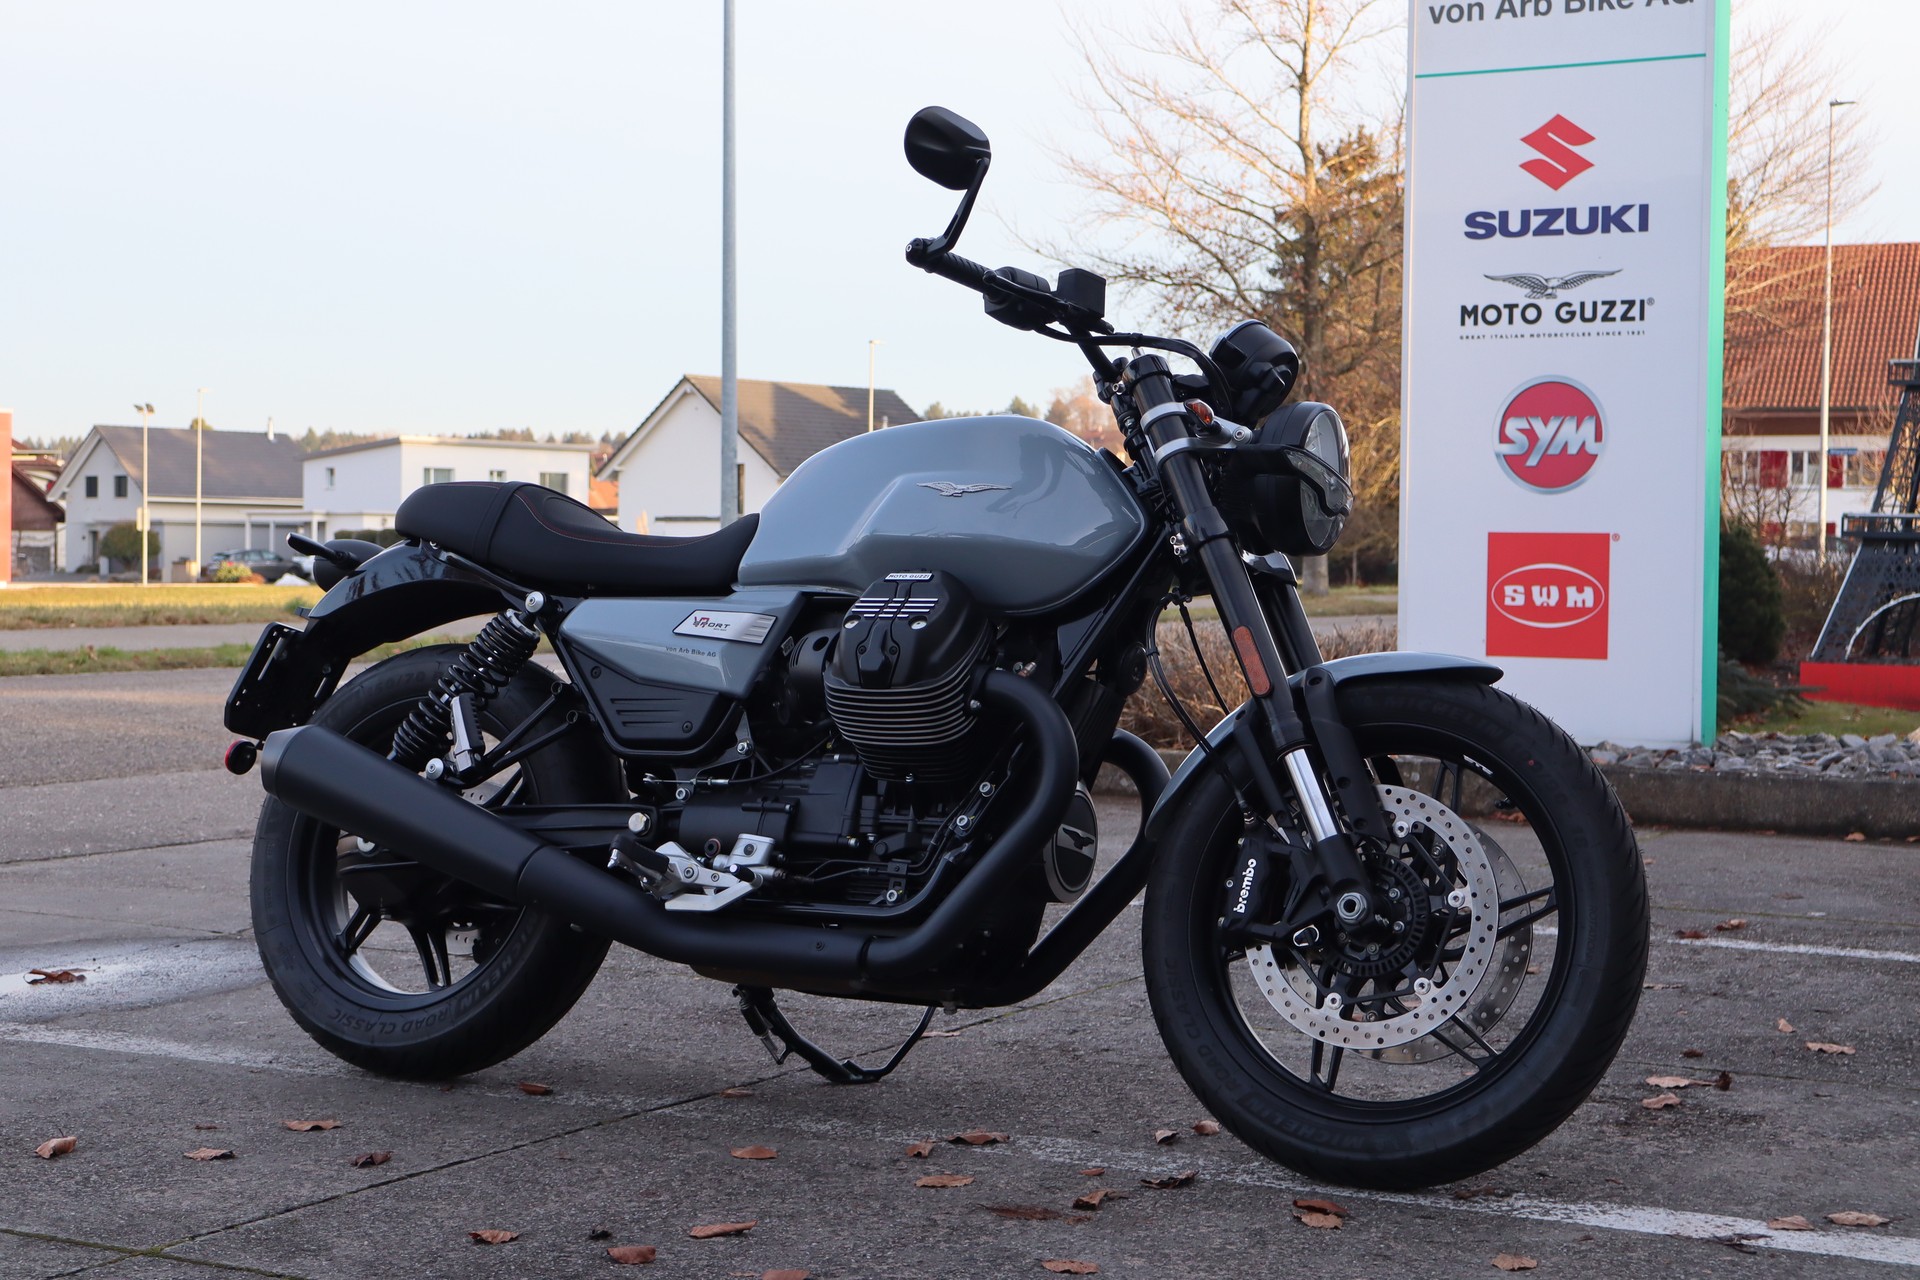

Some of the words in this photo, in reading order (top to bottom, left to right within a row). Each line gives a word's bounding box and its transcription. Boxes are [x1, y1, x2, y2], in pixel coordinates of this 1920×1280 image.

[1429, 2, 1485, 24] von
[1495, 0, 1553, 19] Arb
[1464, 203, 1650, 241] SUZUKI
[1460, 302, 1543, 327] MOTO
[1555, 299, 1646, 325] GUZZI
[1529, 331, 1592, 339] MOTORCYCLES
[1496, 415, 1603, 467] SYM
[1503, 584, 1595, 609] SWM
[691, 648, 706, 657] Bike
[1233, 858, 1257, 914] brembo
[327, 1008, 397, 1035] CLASSIC
[401, 1005, 450, 1033] ROAD
